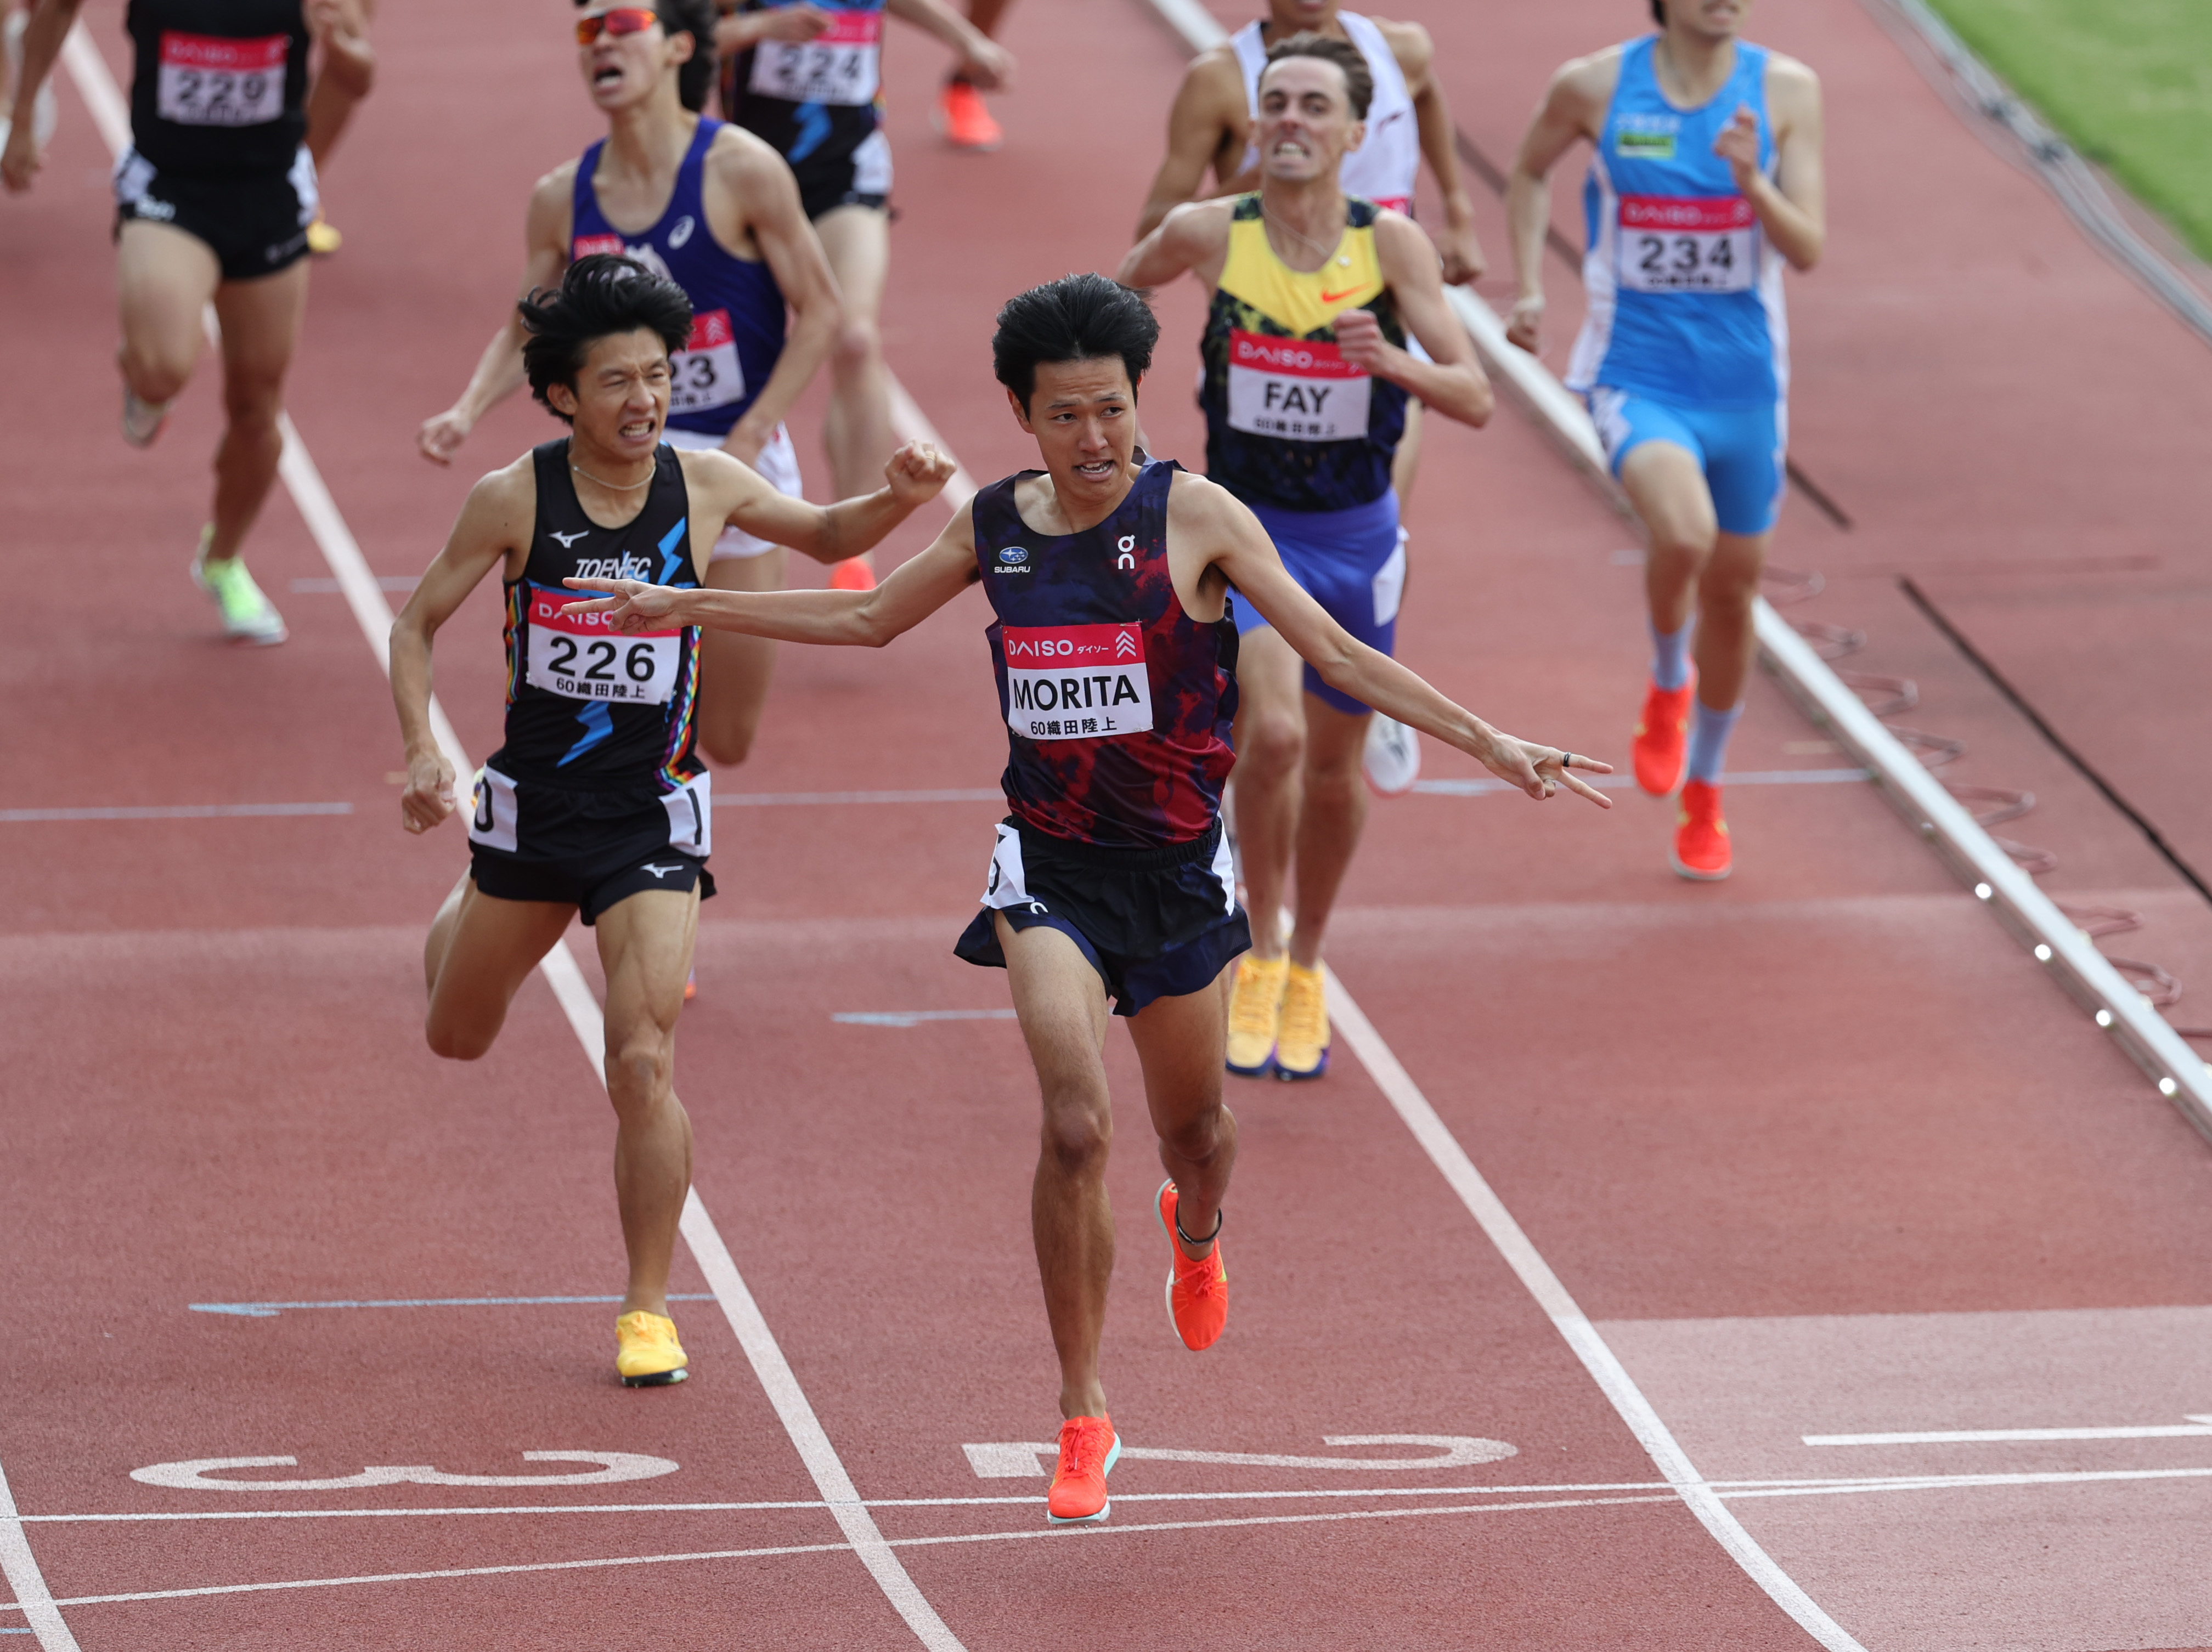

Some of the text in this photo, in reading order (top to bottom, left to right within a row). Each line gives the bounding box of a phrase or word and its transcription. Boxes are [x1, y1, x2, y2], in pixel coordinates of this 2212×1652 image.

[1639, 237, 1733, 271] 234
[1238, 341, 1313, 369] DAISO
[1266, 382, 1330, 414] FAY
[575, 551, 652, 580] TOENEC
[548, 637, 655, 681] 226
[1008, 639, 1109, 657] DAISO ダイソー
[556, 677, 645, 699] 60織田陸上
[1013, 675, 1140, 711] MORITA
[1030, 717, 1117, 736] 60織田陸上
[129, 1450, 680, 1492] 3
